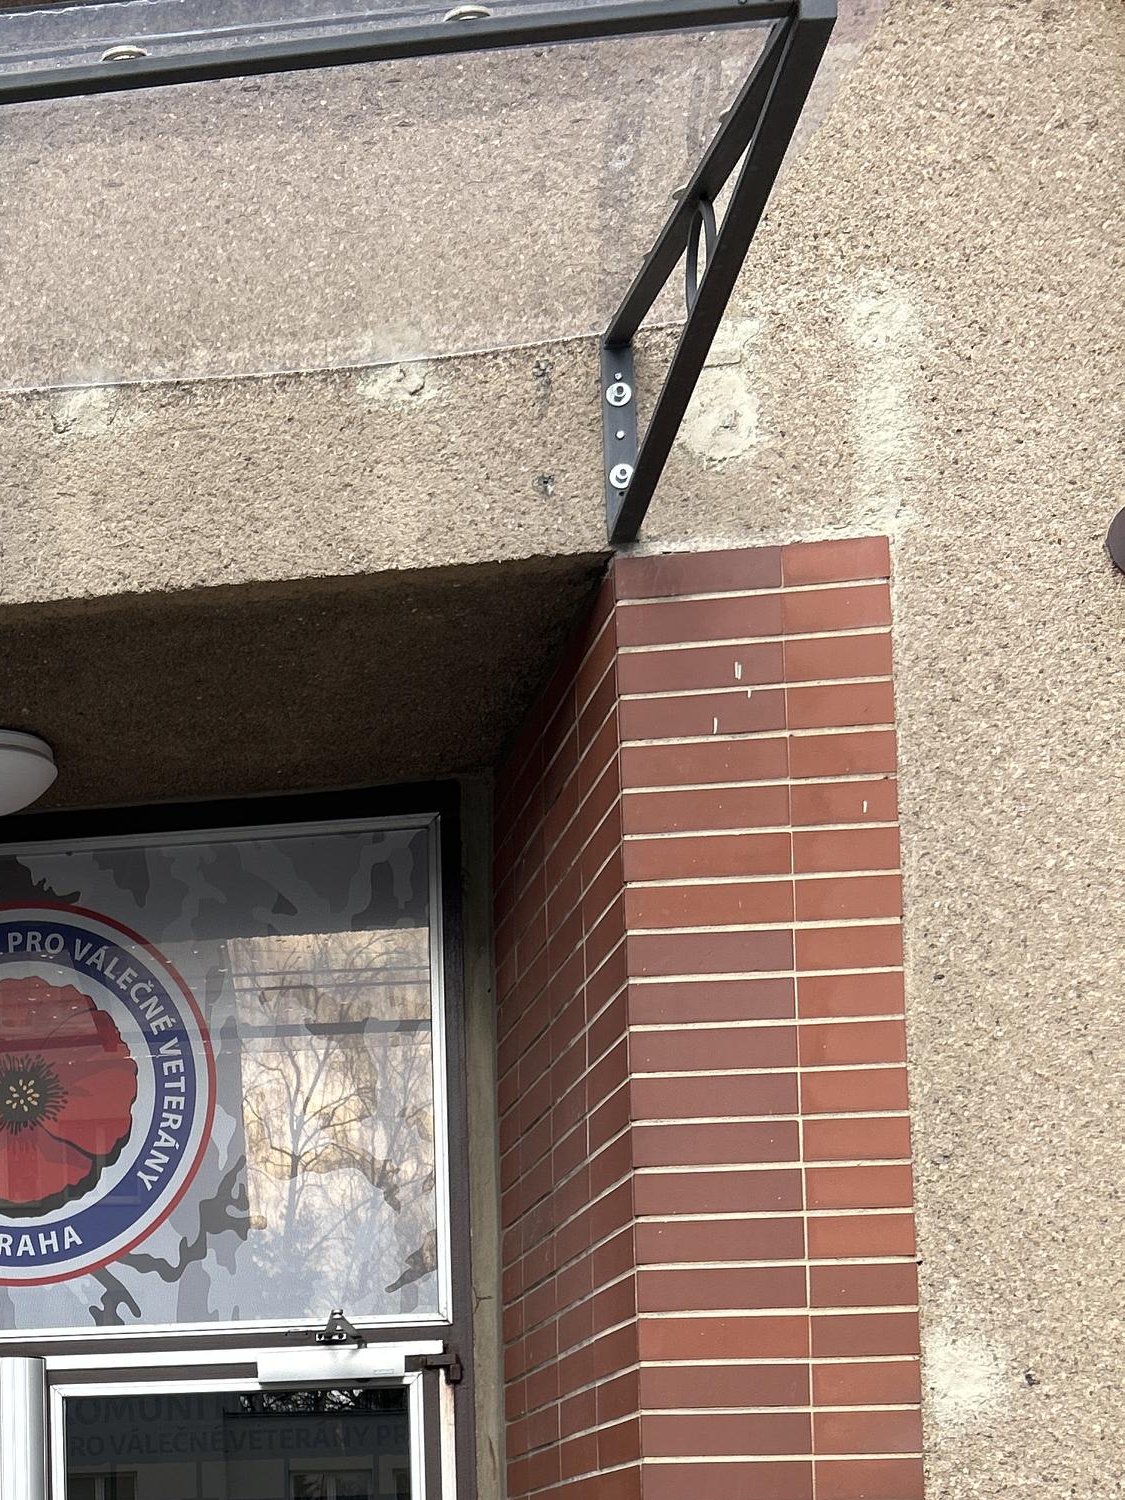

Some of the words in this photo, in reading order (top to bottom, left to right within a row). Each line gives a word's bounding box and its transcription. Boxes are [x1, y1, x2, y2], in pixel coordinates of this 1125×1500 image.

[7, 930, 66, 955] PRO
[74, 938, 176, 1036] VÁLEČNÉ
[136, 1036, 186, 1192] VETERÁNY
